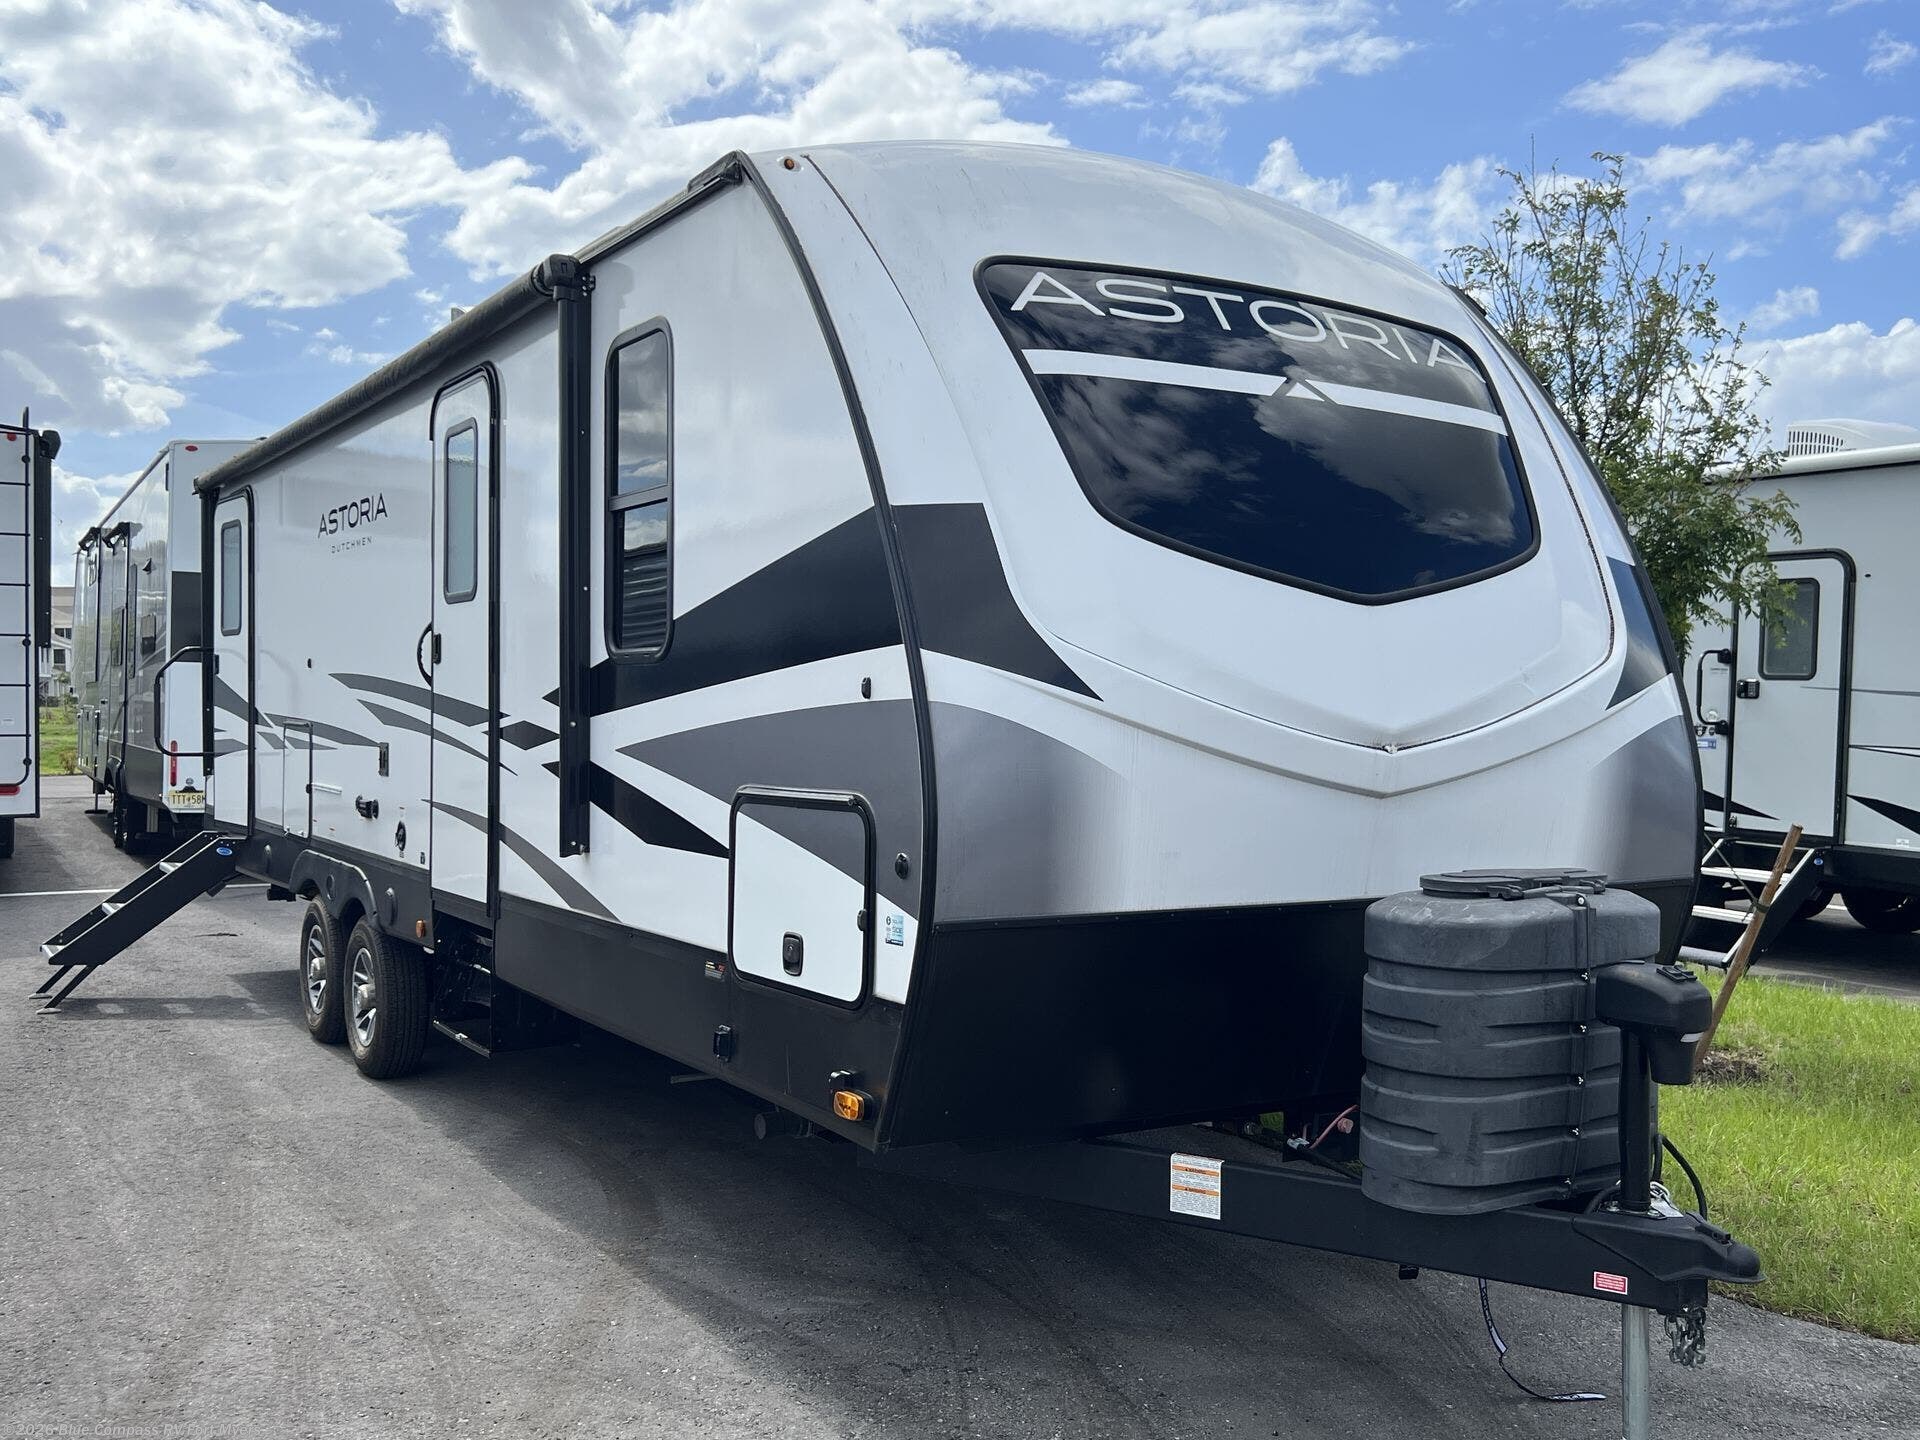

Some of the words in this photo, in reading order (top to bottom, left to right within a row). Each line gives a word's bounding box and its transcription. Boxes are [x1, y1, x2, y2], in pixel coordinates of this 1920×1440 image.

[1010, 271, 1486, 383] ASTORIA
[317, 492, 388, 539] ASTORIA
[331, 536, 372, 554] DUTCHMEN
